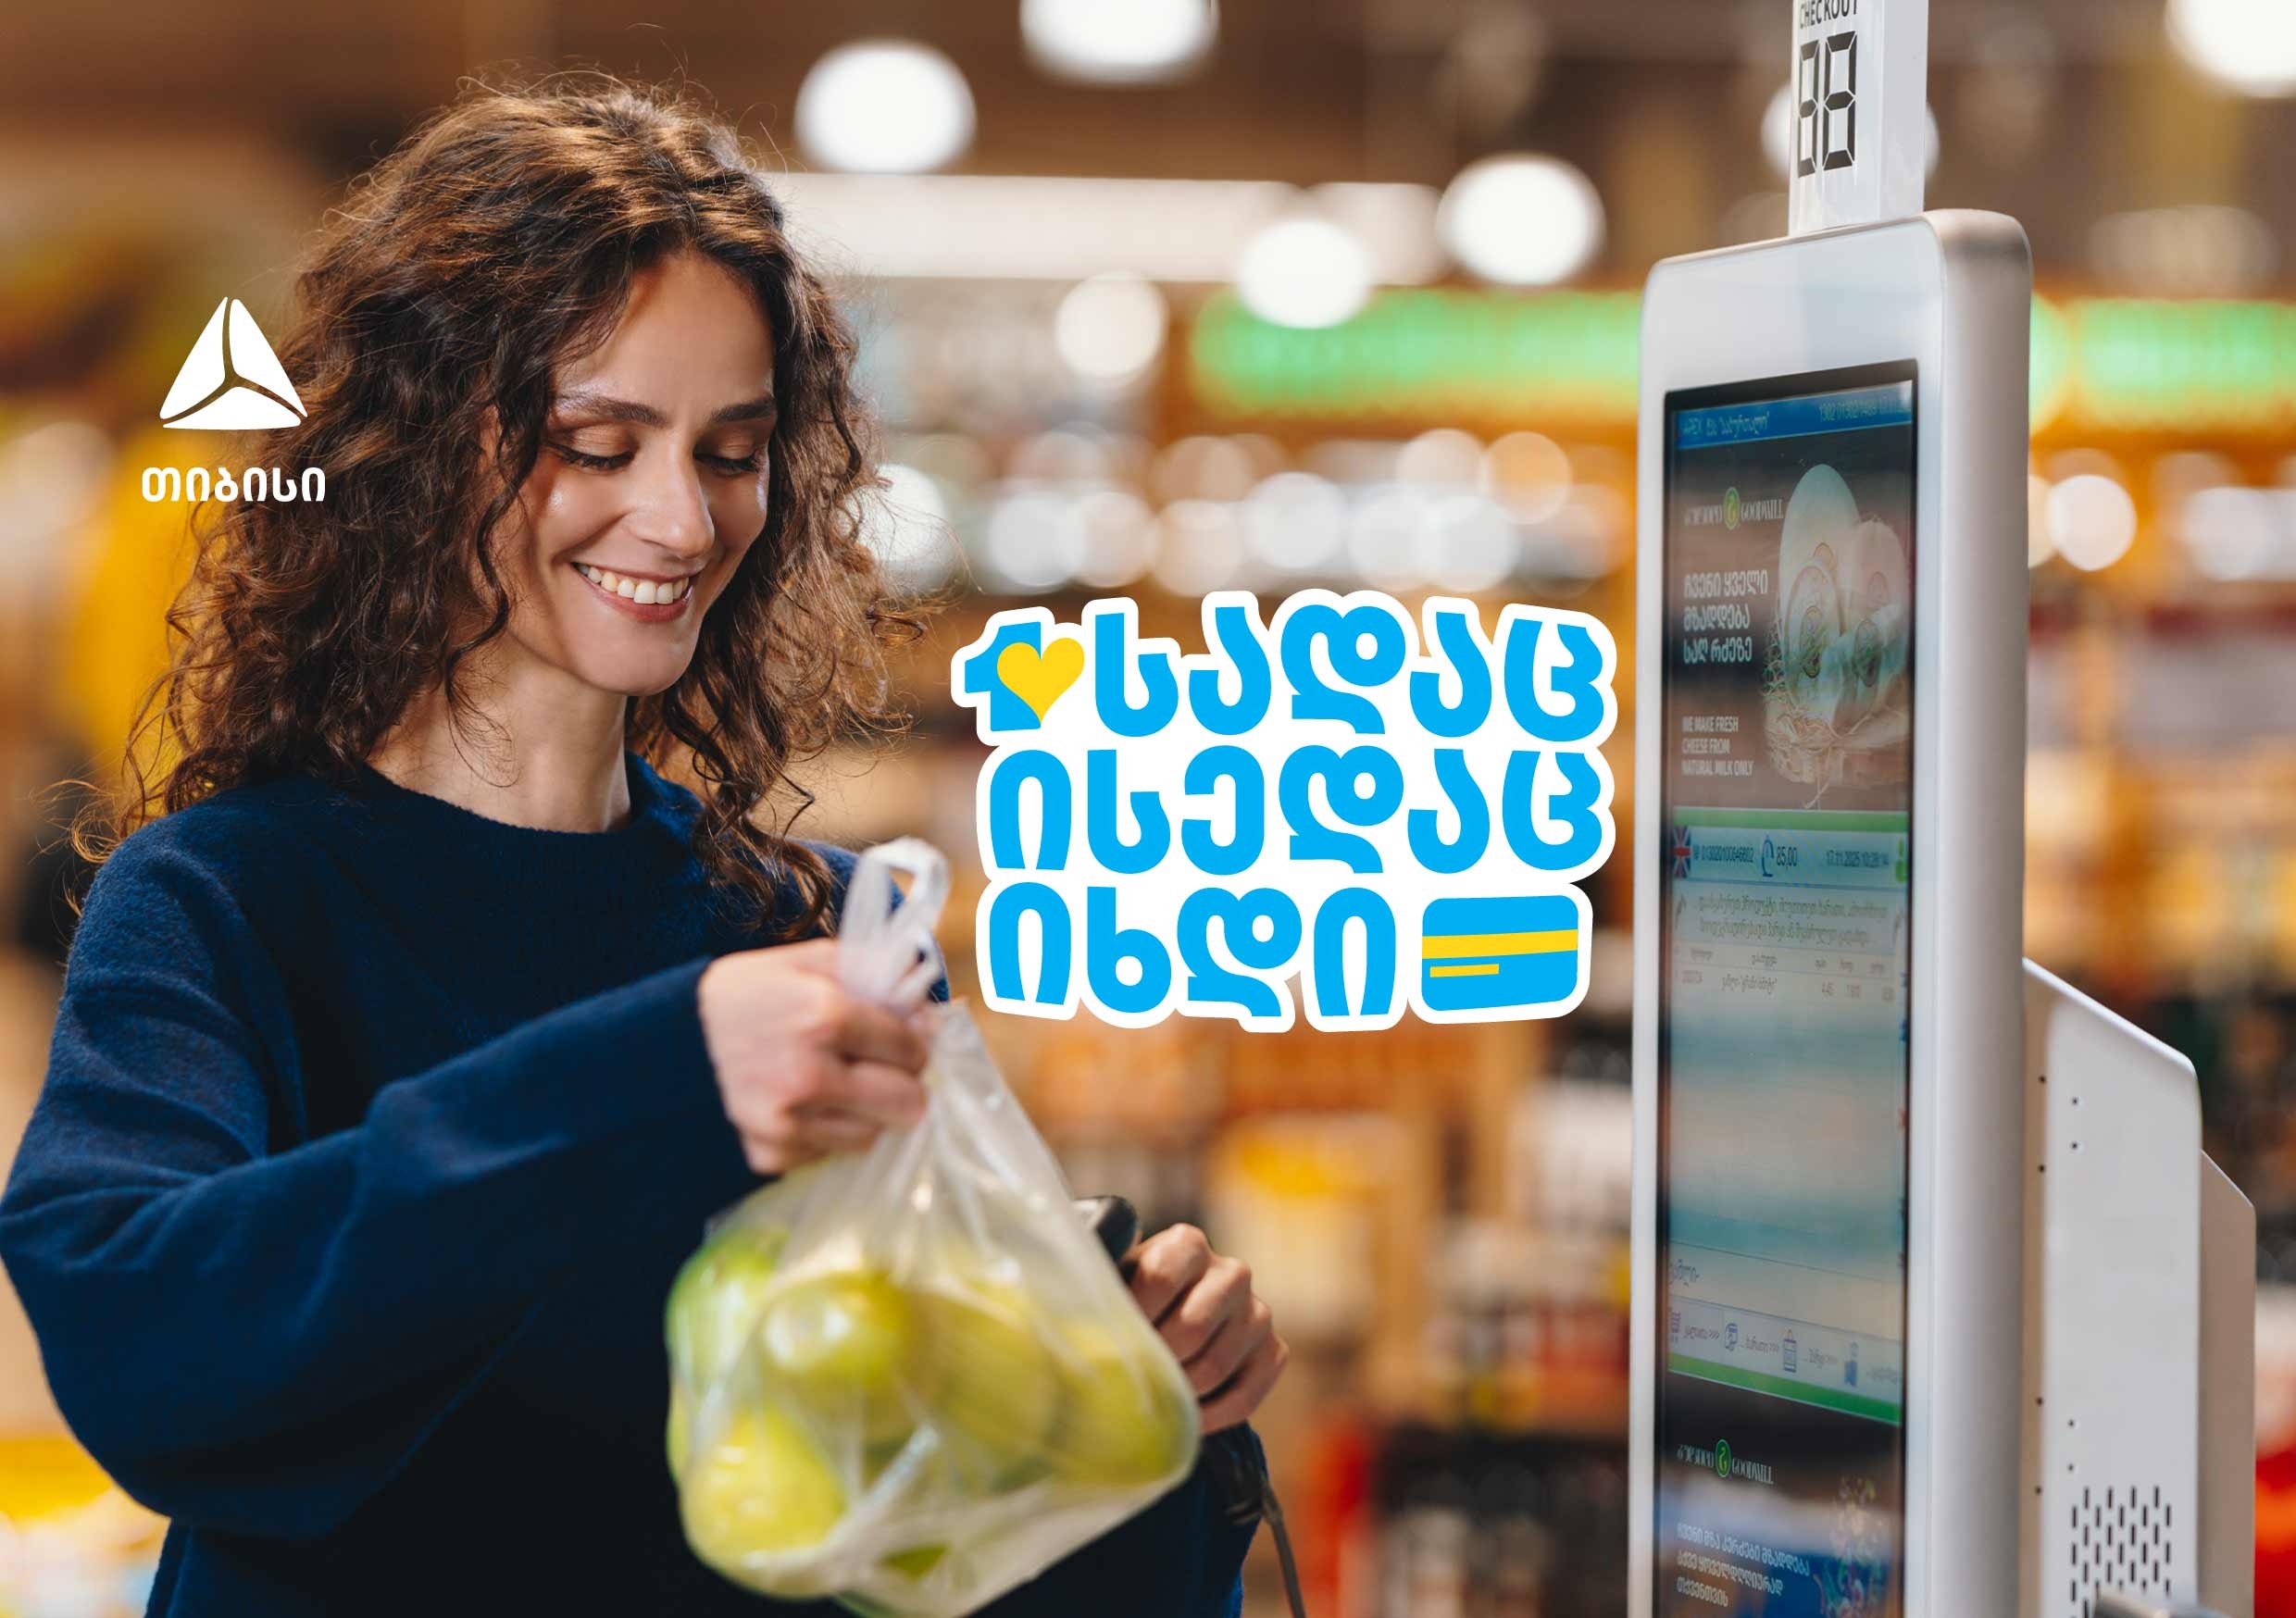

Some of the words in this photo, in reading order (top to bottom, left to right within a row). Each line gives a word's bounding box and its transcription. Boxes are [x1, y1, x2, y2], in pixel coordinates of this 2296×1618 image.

[1723, 569, 1768, 596] ყველი
[1710, 636, 1753, 663] რძეზე
[1716, 716, 1740, 732] FRESH
[1734, 759, 1754, 776] ONLY
